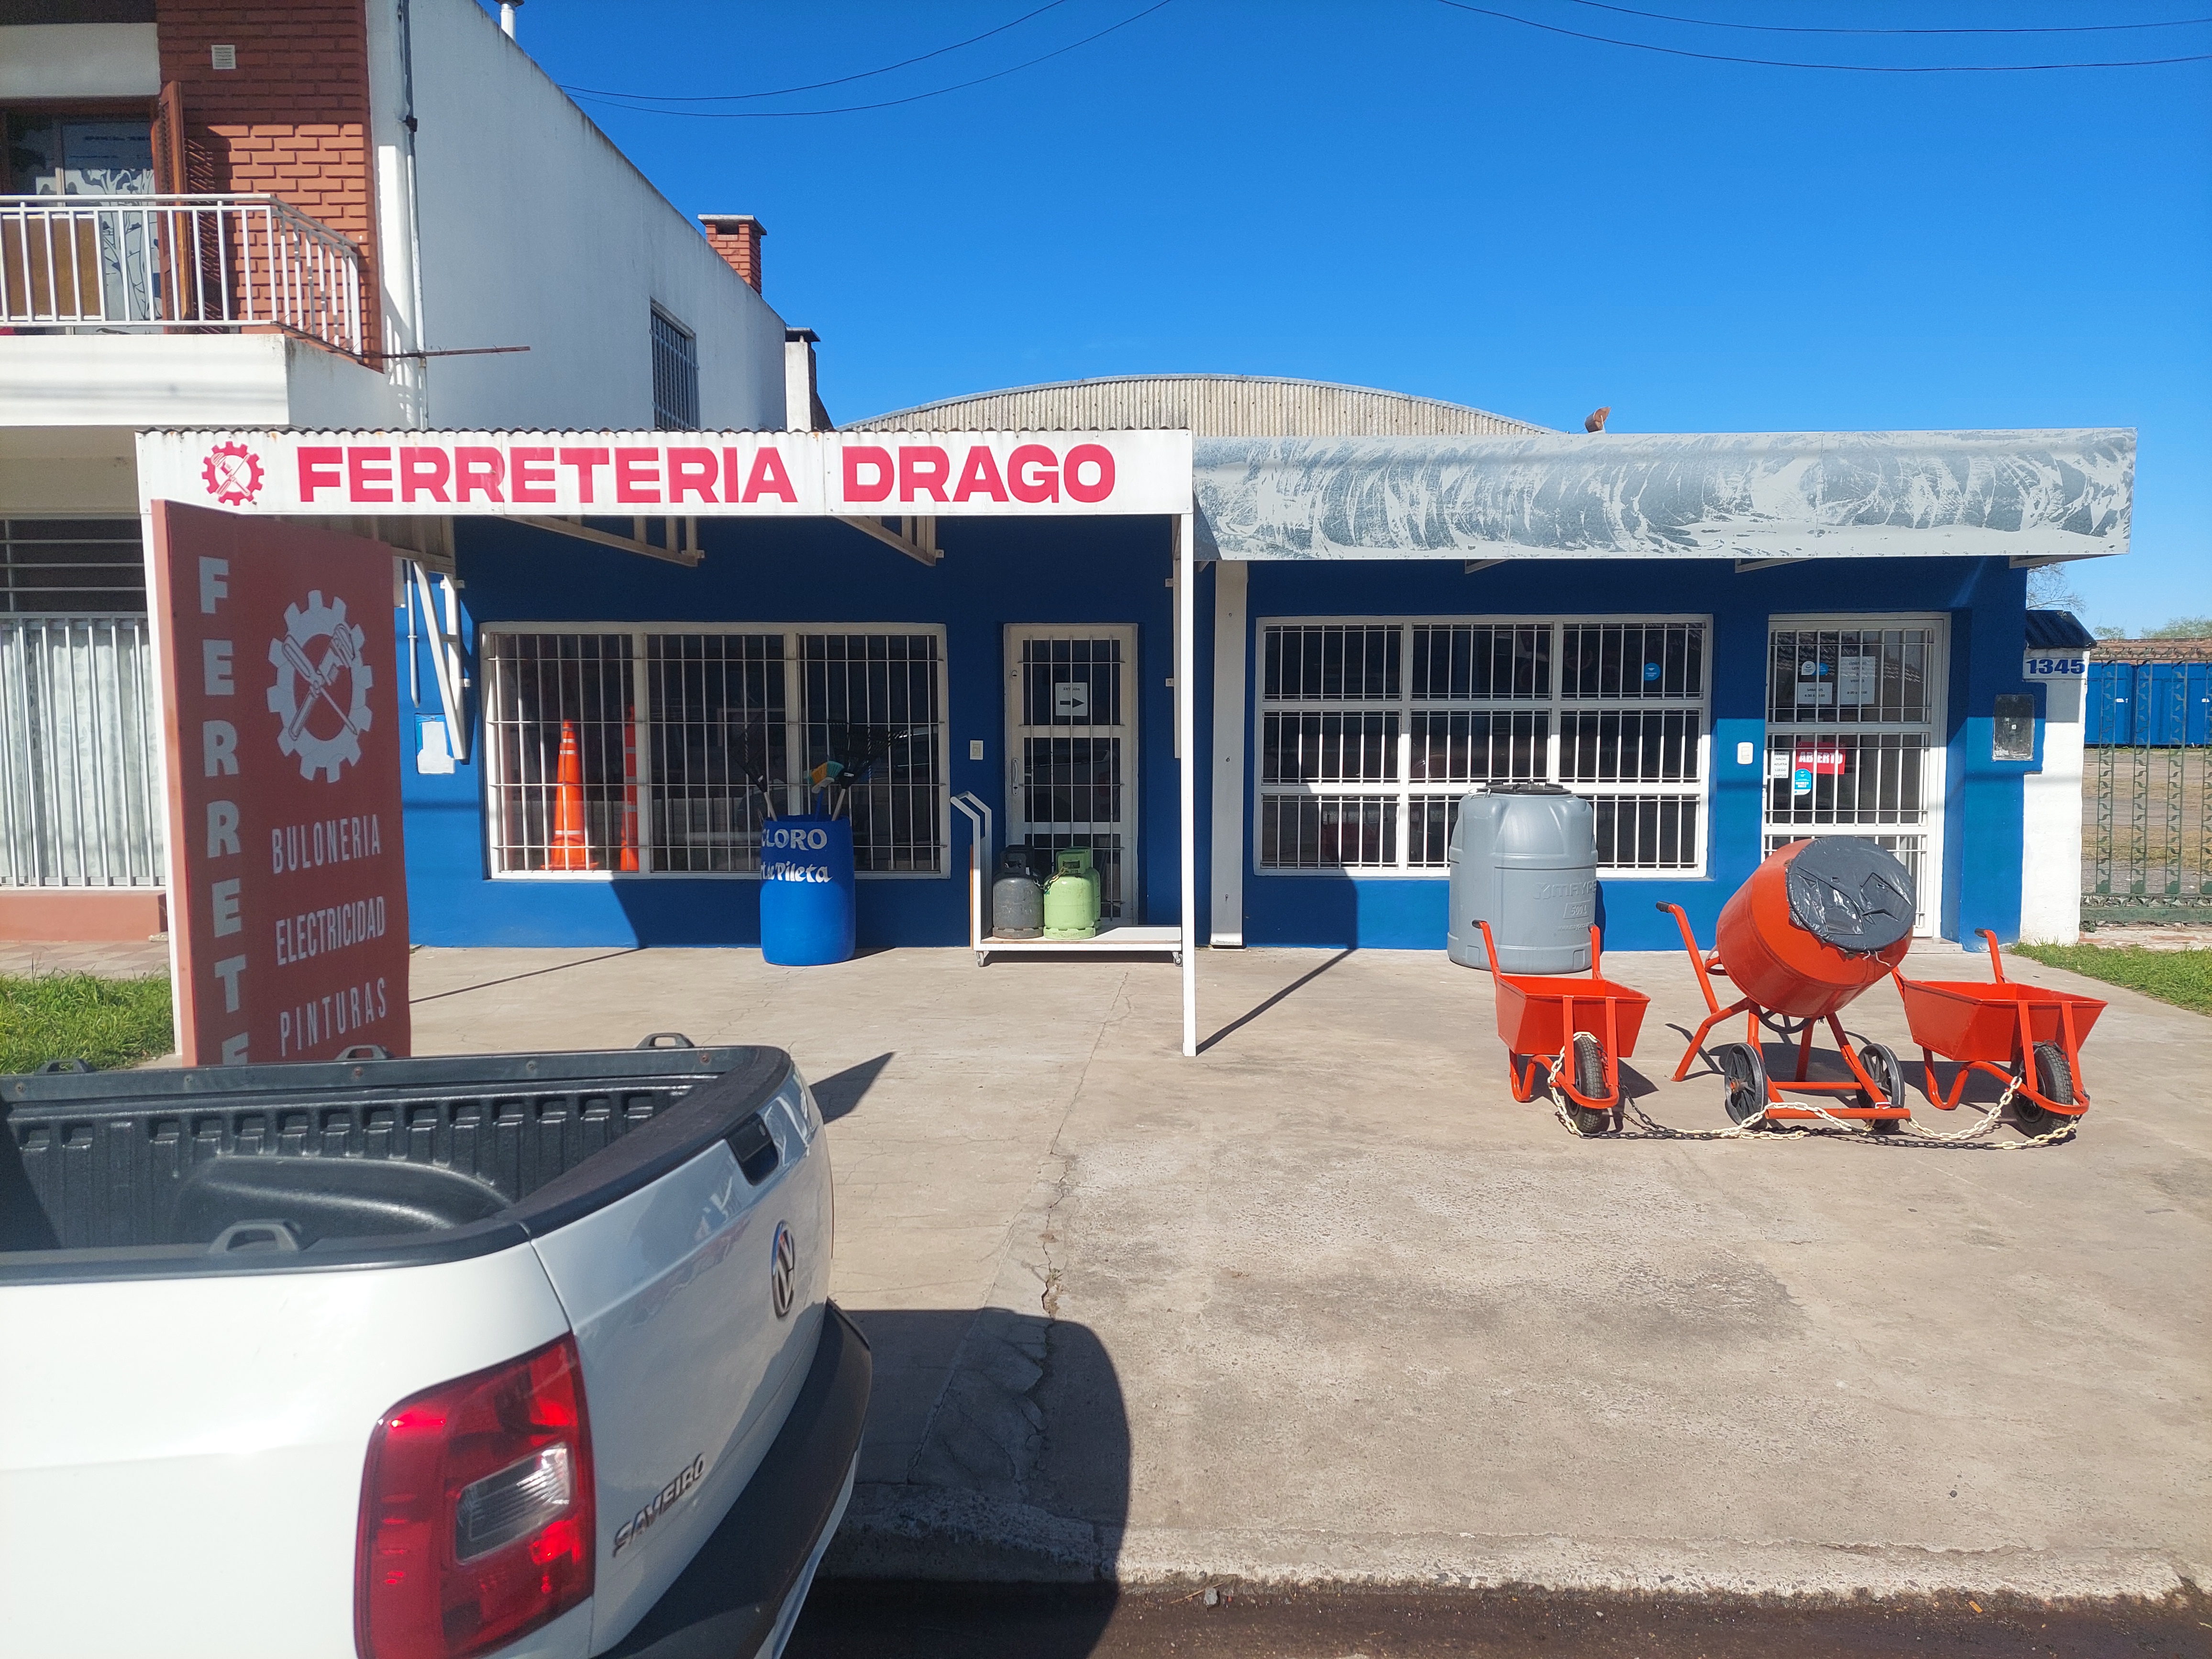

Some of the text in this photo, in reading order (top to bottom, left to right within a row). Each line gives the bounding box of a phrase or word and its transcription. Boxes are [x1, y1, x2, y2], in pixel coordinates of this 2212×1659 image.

[297, 444, 1116, 503] FERRETERIA DRAGO
[2025, 659, 2086, 674] 1345
[1798, 752, 1843, 764] ABERTO
[272, 814, 381, 874] BULONERIA
[775, 861, 833, 883] Pileta
[276, 896, 385, 966] ELECTRICIDAD
[1571, 905, 1583, 916] 500
[280, 977, 386, 1057] PINTURAS
[612, 1451, 706, 1558] SAVEIRO
